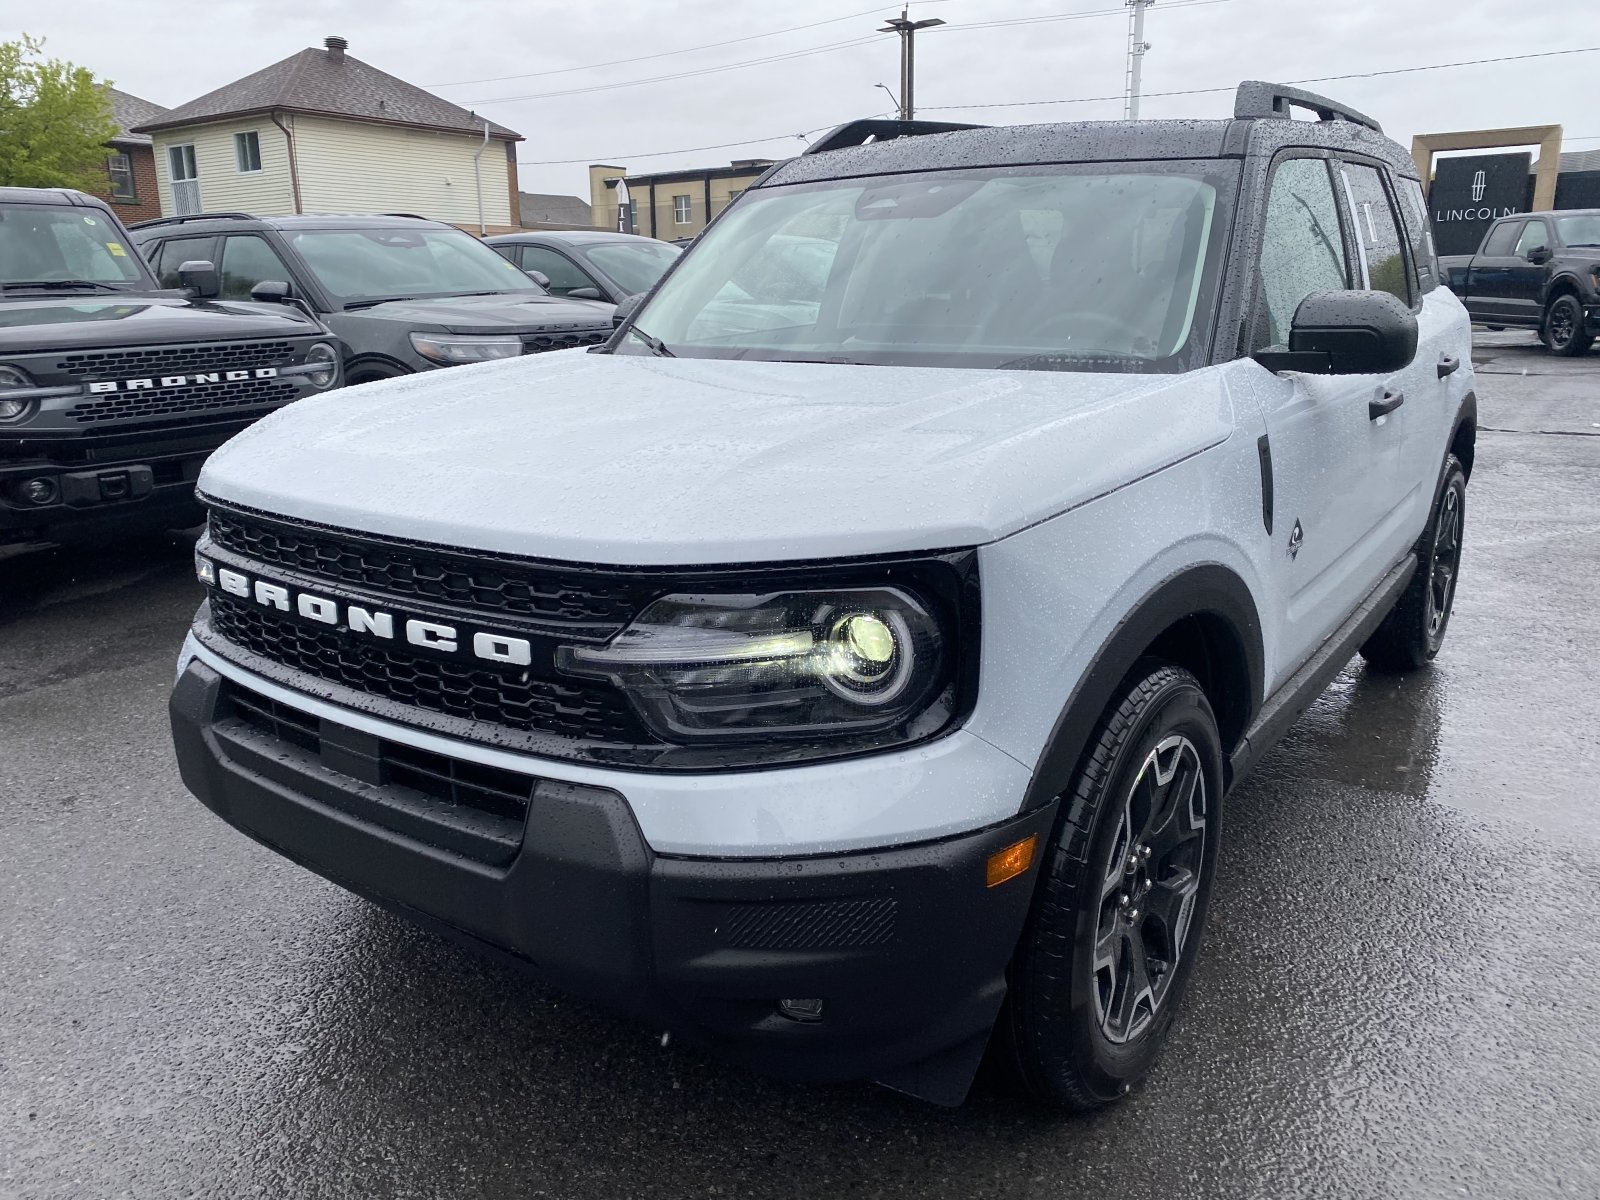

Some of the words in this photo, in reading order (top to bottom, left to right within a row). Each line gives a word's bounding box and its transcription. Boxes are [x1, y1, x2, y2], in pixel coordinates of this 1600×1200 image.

[1437, 206, 1516, 222] LINCOLN
[89, 367, 278, 393] BRONCO
[219, 567, 532, 666] BRONCO
